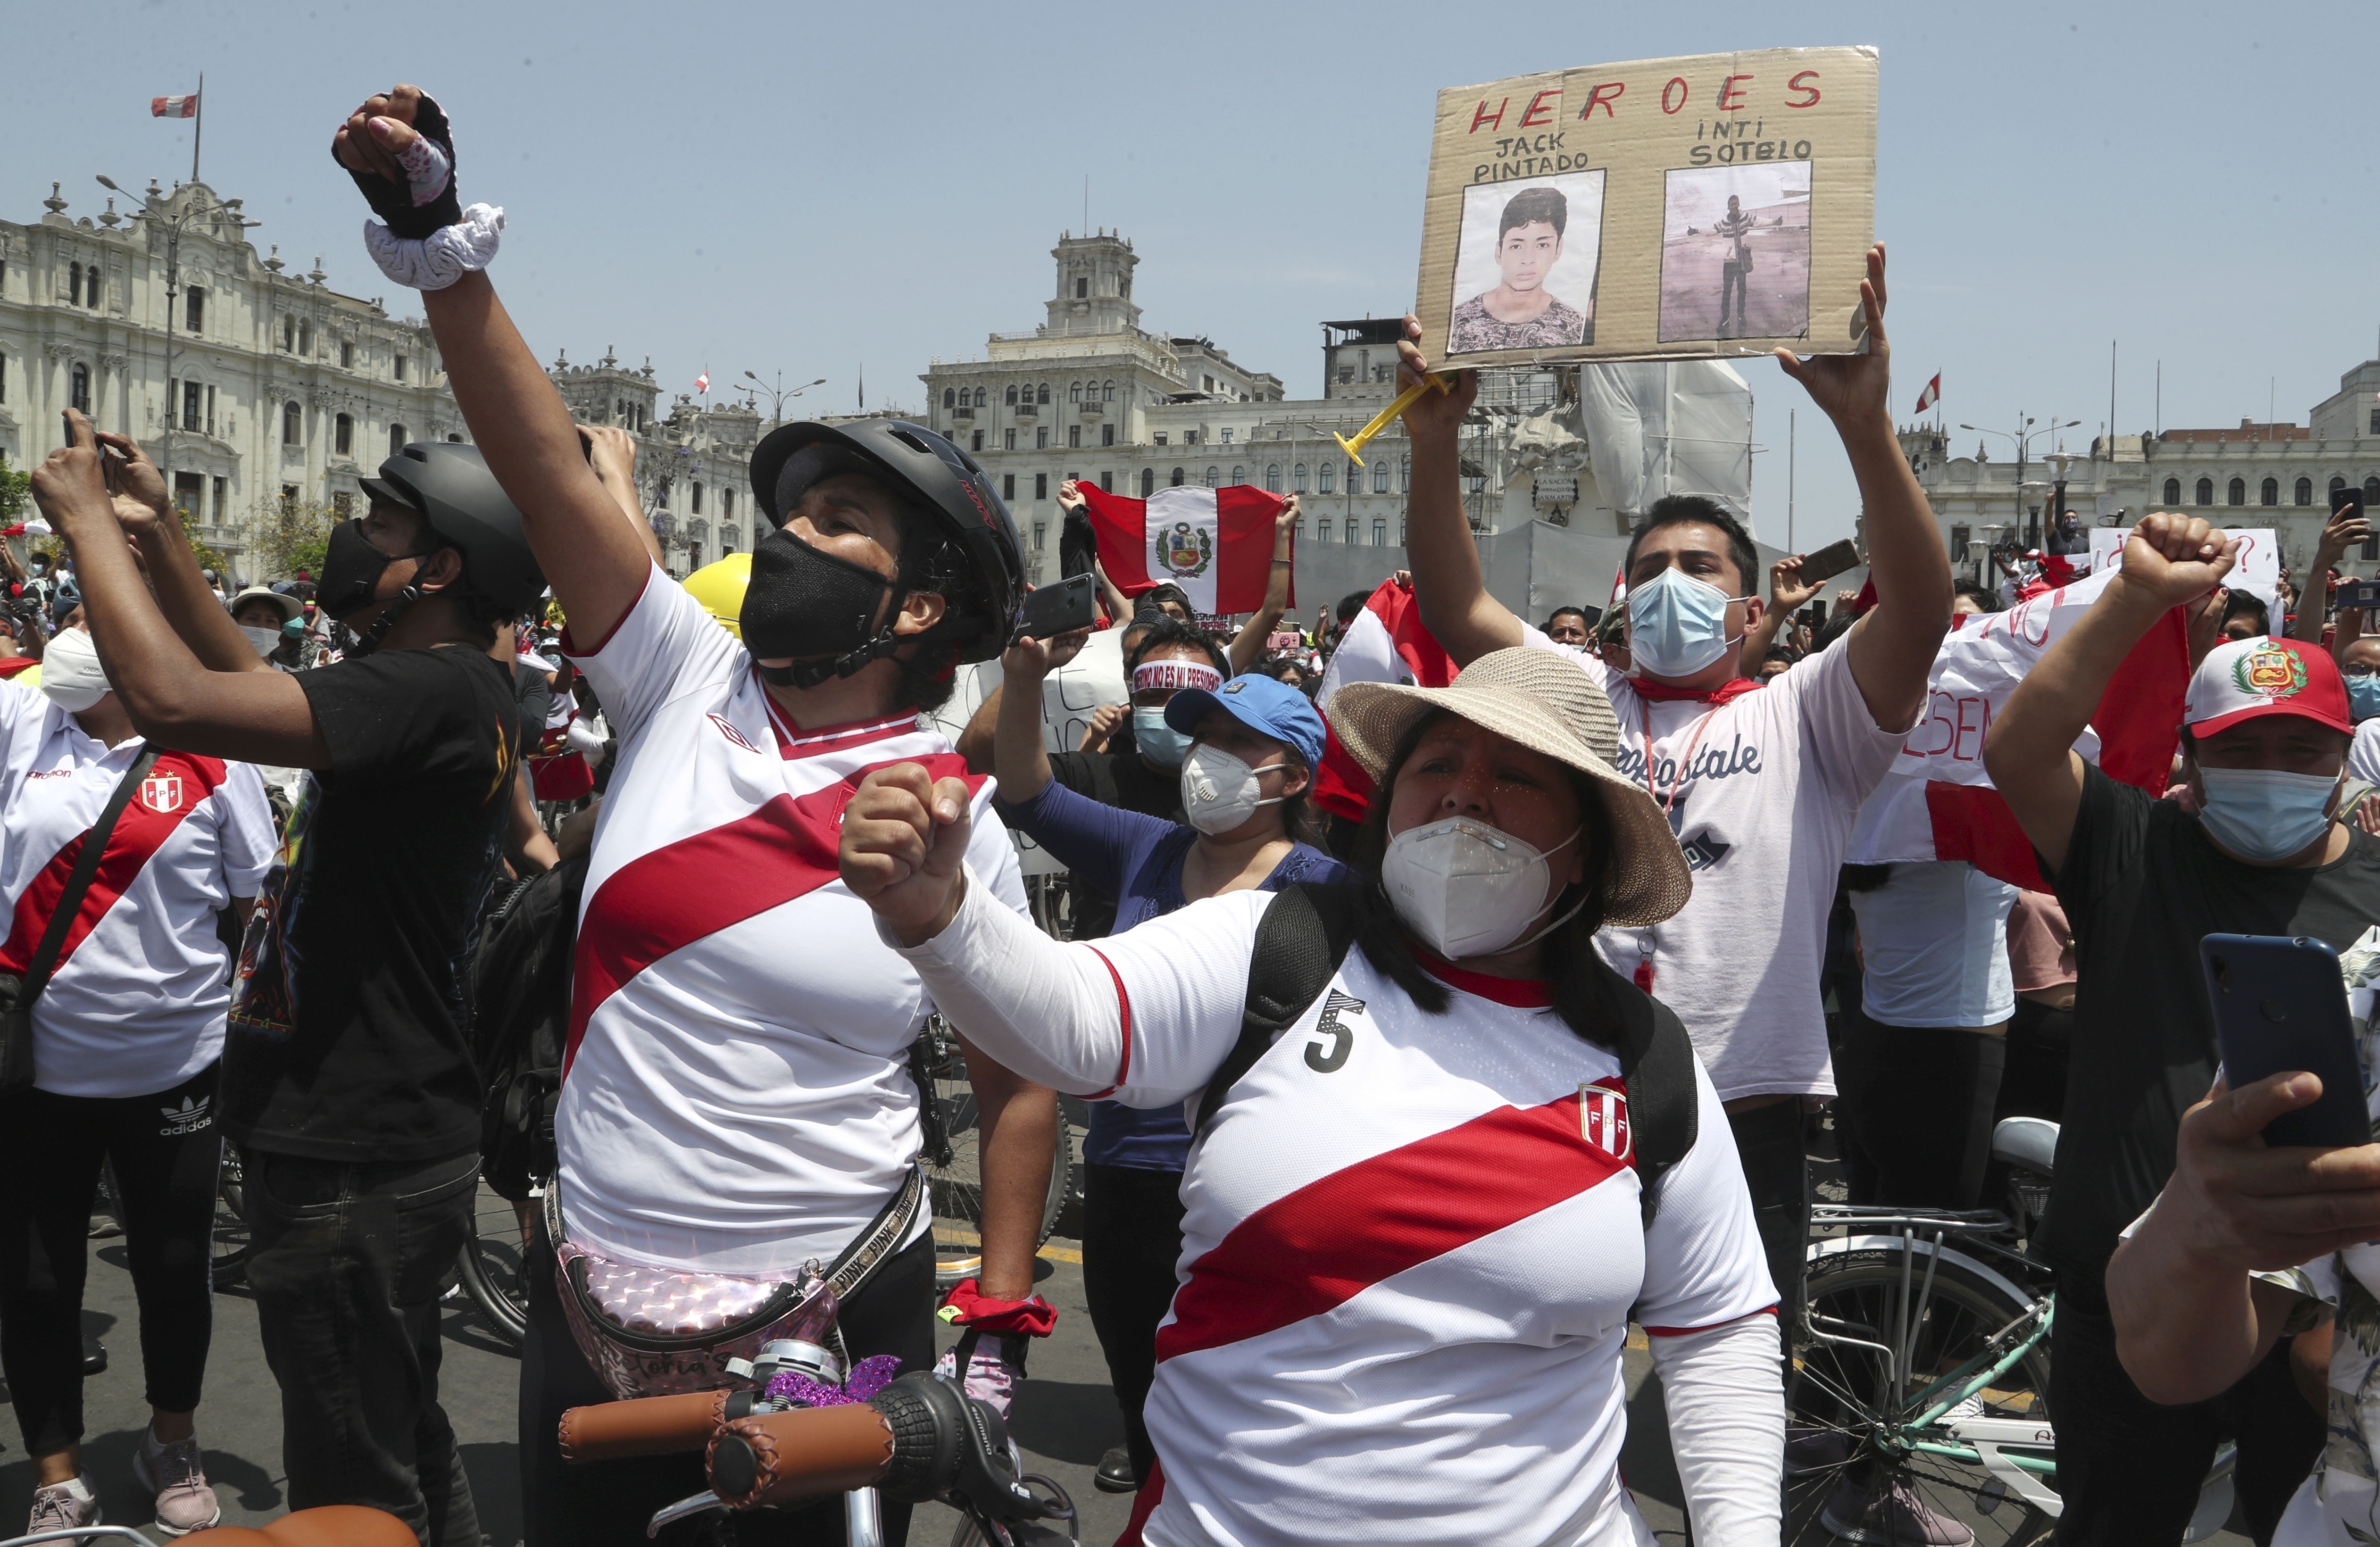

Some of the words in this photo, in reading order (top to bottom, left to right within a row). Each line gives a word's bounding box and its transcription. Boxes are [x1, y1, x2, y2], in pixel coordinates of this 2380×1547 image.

[1468, 69, 1821, 134] HEROES
[1495, 132, 1566, 158] JACK
[1689, 140, 1812, 166] SOTELO
[1474, 152, 1588, 183] PINTADO
[1154, 665, 1164, 688] NO
[1165, 665, 1174, 688] ES
[1176, 666, 1186, 688] MI
[149, 790, 176, 798] FPF
[1304, 988, 1366, 1073] 5
[160, 1117, 212, 1136] adidas
[1590, 1111, 1626, 1133] FPF
[835, 1256, 868, 1291] PINK
[868, 1225, 895, 1260] PINK
[971, 1406, 992, 1456] SHIMANO
